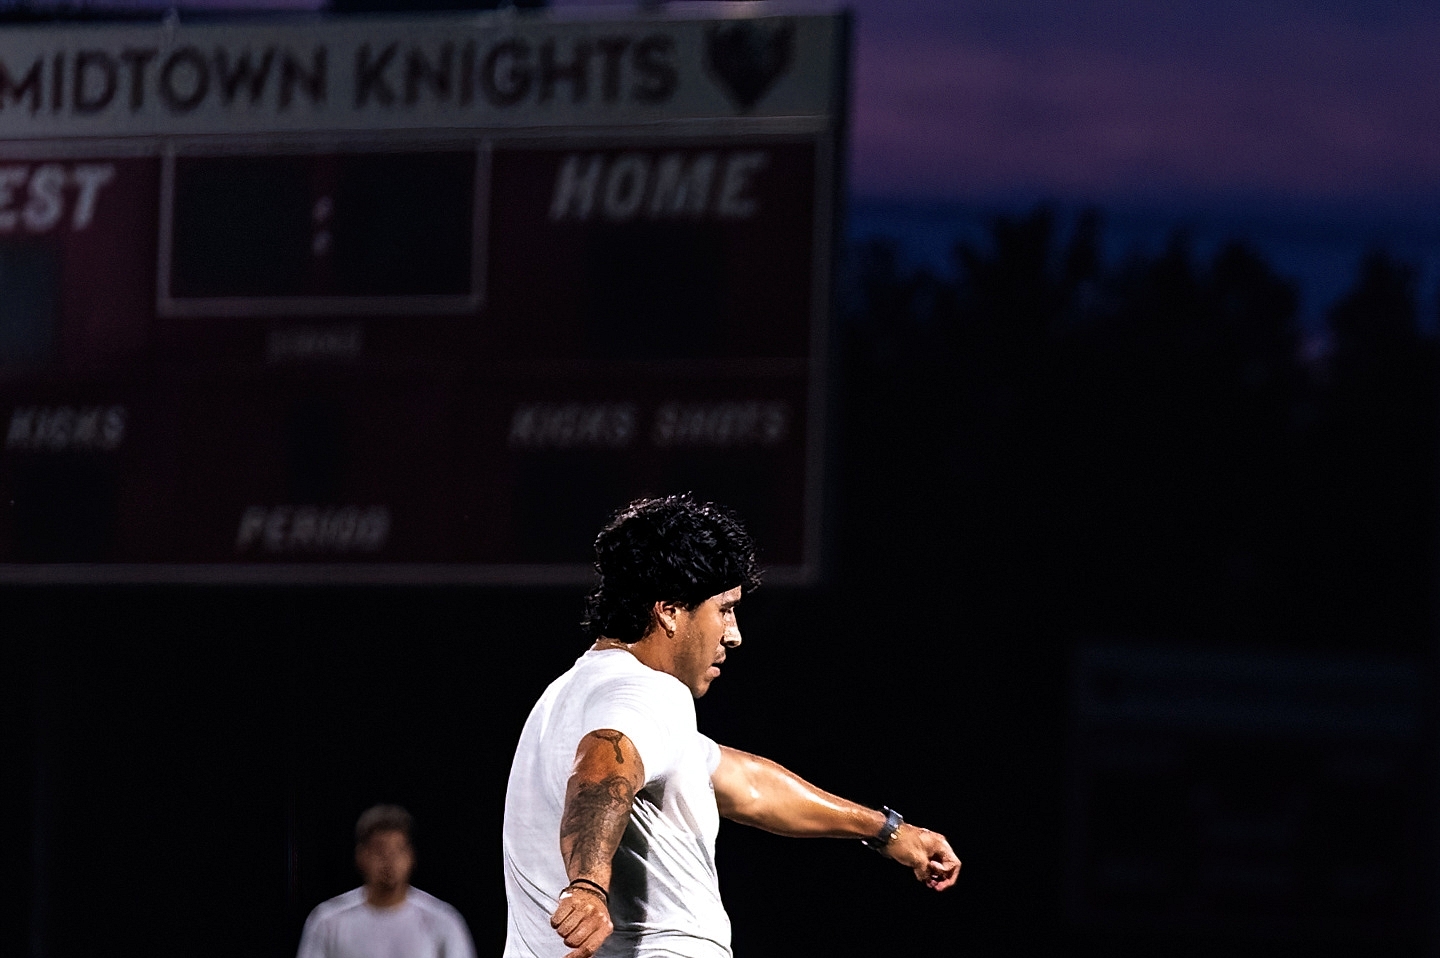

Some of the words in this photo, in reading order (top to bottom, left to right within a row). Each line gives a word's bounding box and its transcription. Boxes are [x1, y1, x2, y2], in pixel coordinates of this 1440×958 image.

[0, 45, 328, 116] MIDTOWN
[353, 34, 680, 108] KNIGHTS
[548, 149, 768, 223] HOME
[235, 503, 392, 553] PERIOD
